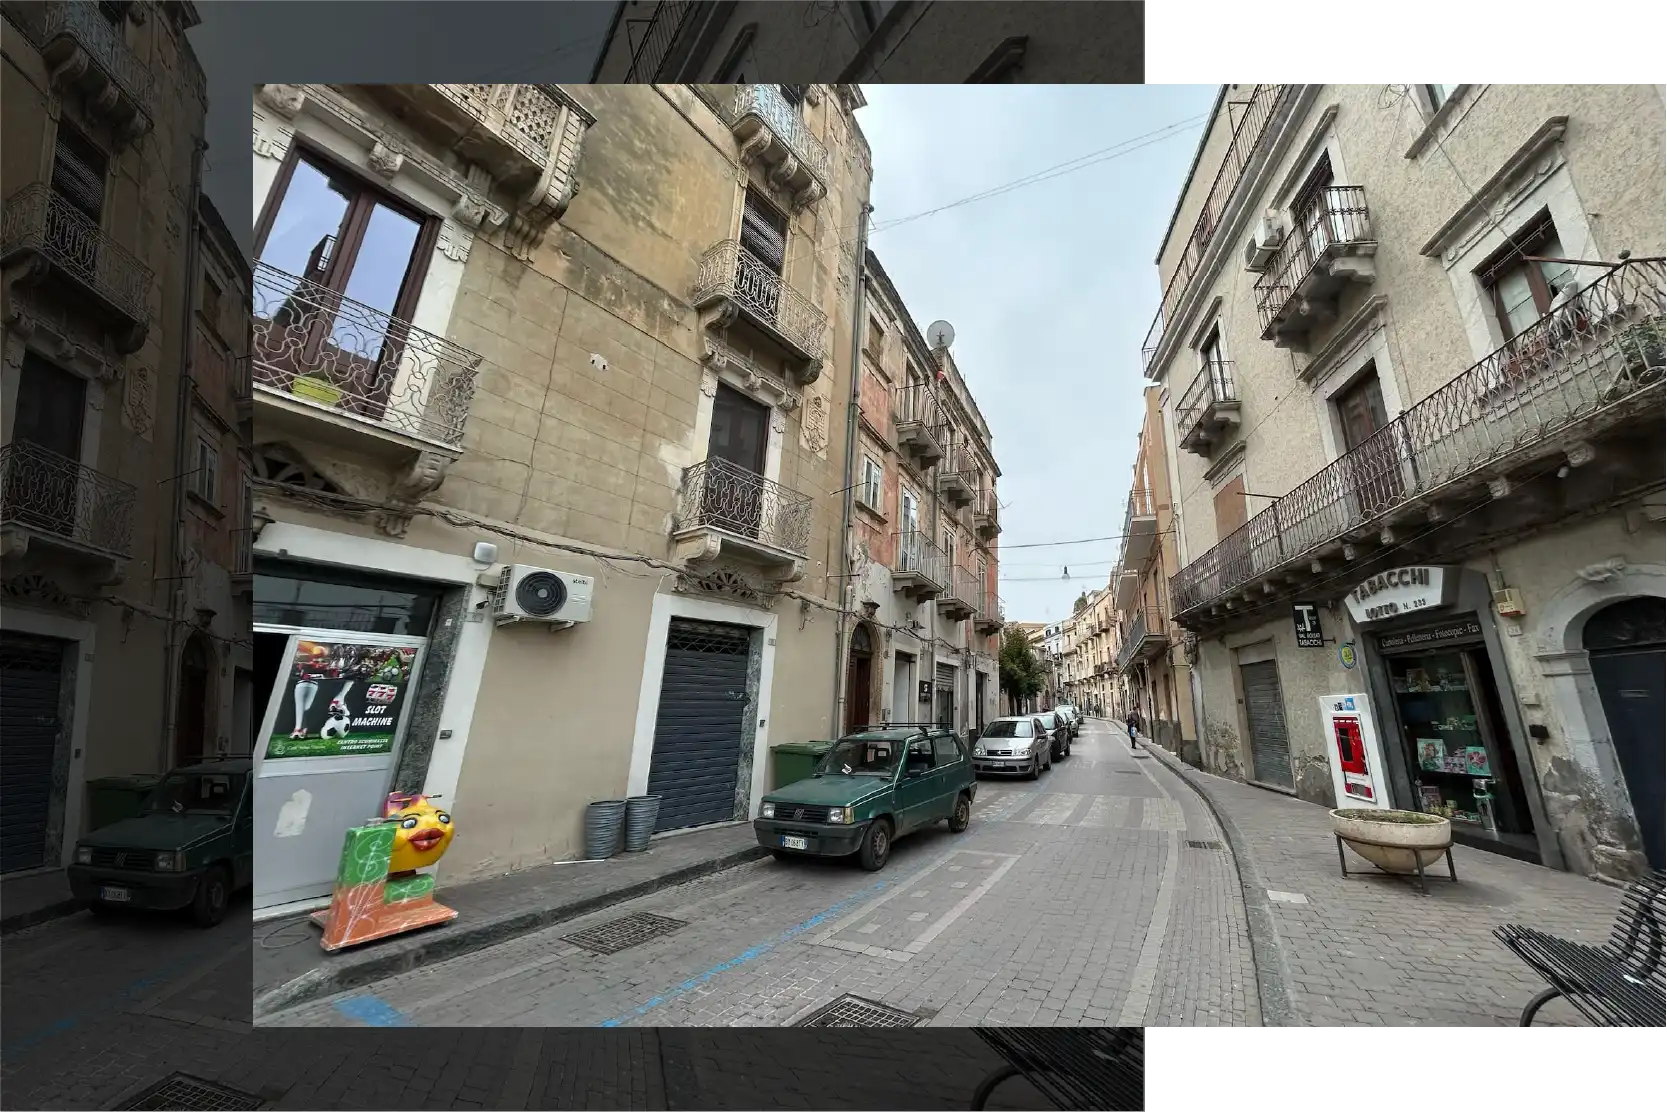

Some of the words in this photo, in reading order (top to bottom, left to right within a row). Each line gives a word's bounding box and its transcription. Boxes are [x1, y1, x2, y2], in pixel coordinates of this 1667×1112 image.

[1351, 568, 1430, 604] TABACCHI
[1365, 602, 1399, 619] LOTTO
[1467, 623, 1480, 633] Fax
[365, 705, 388, 714] SLOT
[351, 717, 394, 726] MACHINE
